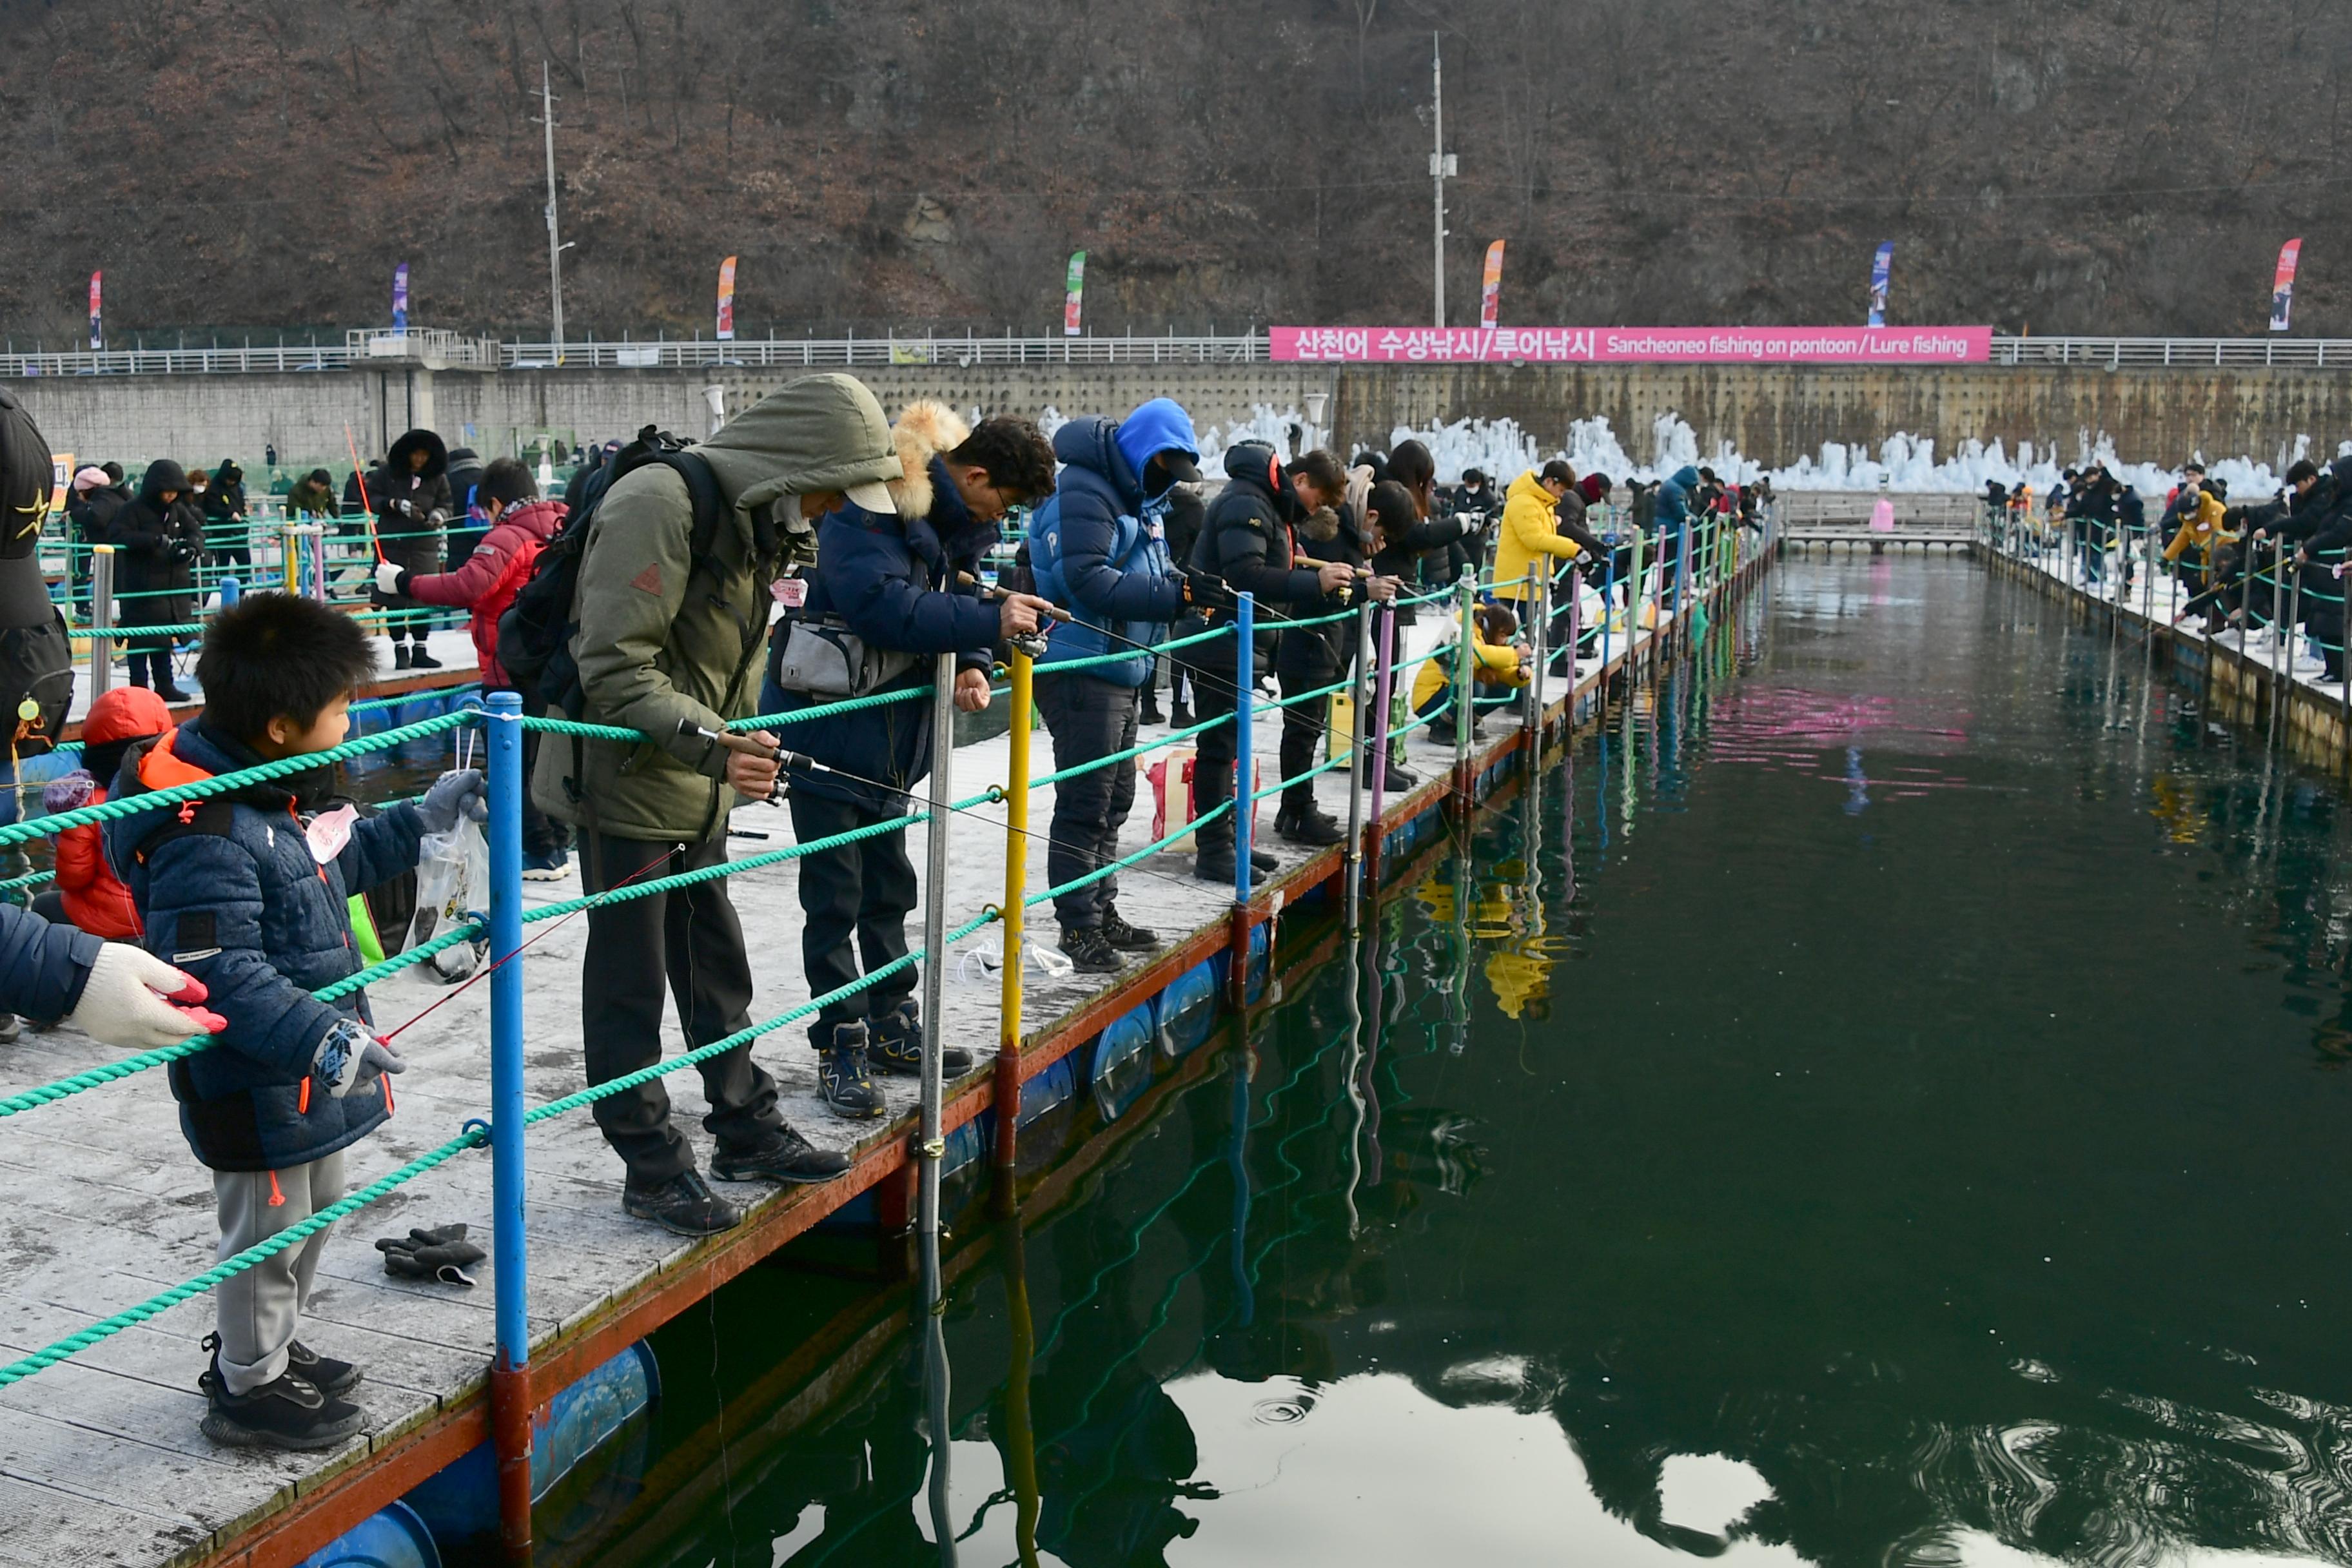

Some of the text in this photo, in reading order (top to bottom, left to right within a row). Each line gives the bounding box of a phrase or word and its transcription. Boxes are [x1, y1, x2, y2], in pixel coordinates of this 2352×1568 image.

[1295, 329, 1368, 360] 산천어
[1607, 335, 1707, 353] Sancheoneo
[1710, 335, 1763, 358] fishing
[1765, 339, 1787, 353] on
[1912, 335, 1968, 358] fishing
